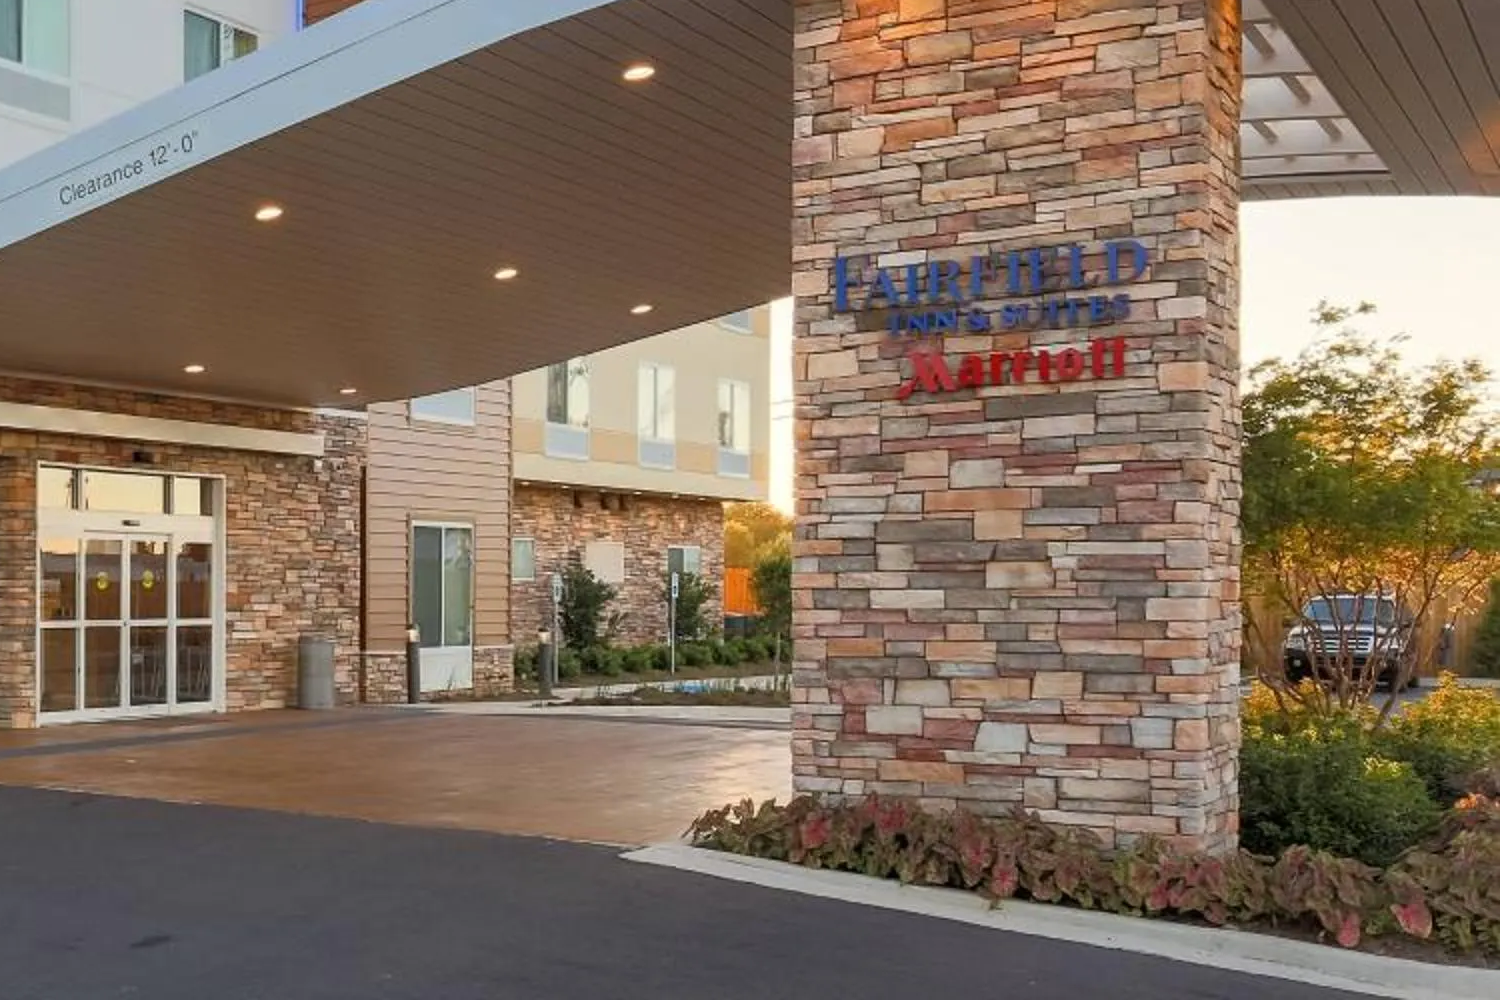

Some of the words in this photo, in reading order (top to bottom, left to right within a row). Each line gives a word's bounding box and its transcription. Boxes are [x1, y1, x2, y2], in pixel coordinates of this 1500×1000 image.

[59, 159, 143, 205] Clearance
[833, 239, 1151, 313] FAIRFIELD
[888, 310, 958, 336] INN
[1002, 293, 1132, 329] SUITES
[894, 335, 1128, 400] Marriott
